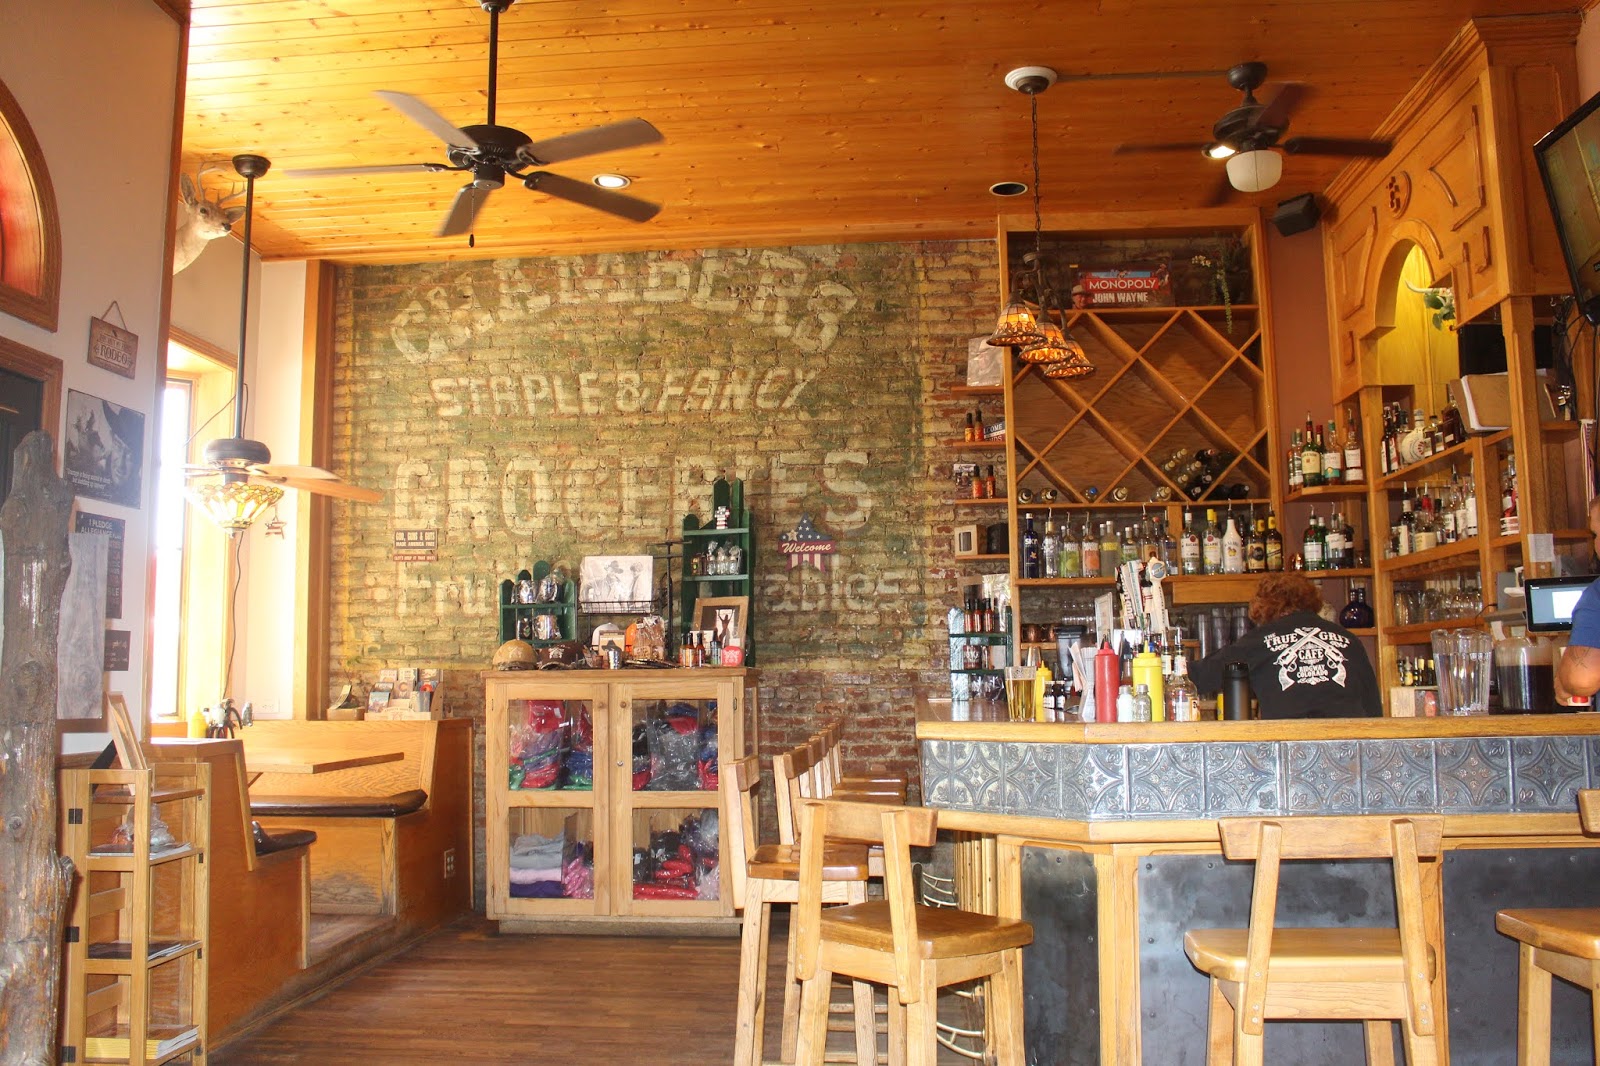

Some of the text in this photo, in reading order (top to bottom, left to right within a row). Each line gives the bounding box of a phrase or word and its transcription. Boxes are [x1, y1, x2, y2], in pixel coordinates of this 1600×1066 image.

[1089, 279, 1156, 290] MONOPOLY
[1092, 292, 1149, 303] JOHN WAYNE
[100, 344, 128, 365] RODEO
[430, 366, 819, 416] STAPLE & FANCY
[92, 519, 113, 530] PLEDGE
[407, 531, 418, 541] GUNS
[424, 531, 435, 541] GUTS
[781, 542, 832, 554] Welcome
[1263, 632, 1278, 641] THE
[1263, 631, 1351, 648] TRUE GRIT
[1297, 648, 1325, 660] CAFE
[1298, 664, 1326, 672] RIDGWAY
[1296, 670, 1329, 679] COLORADO
